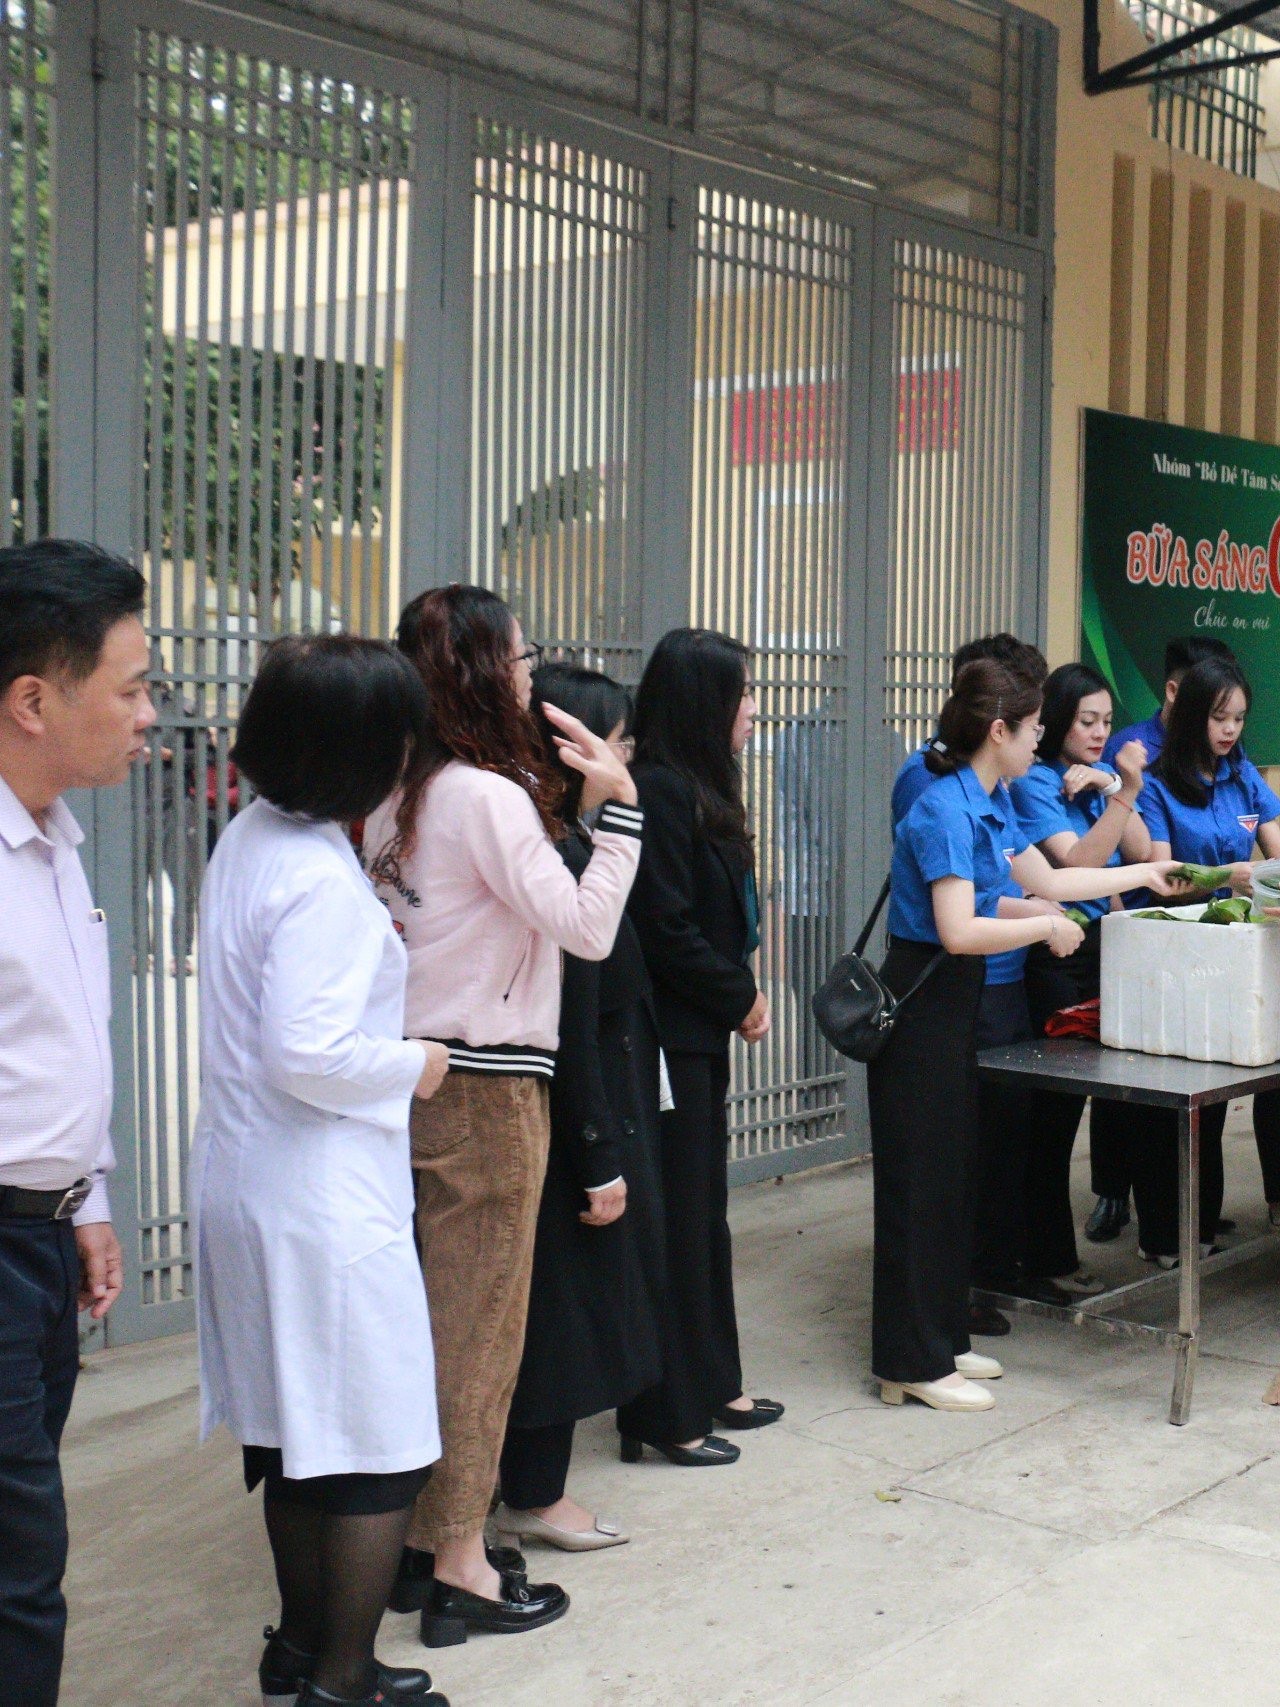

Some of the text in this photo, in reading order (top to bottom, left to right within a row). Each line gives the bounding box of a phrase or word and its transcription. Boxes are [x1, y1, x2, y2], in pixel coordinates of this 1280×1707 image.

[1153, 453, 1191, 478] Nhóm
[1127, 522, 1190, 587] BỮA
[1193, 529, 1267, 593] SÁNG
